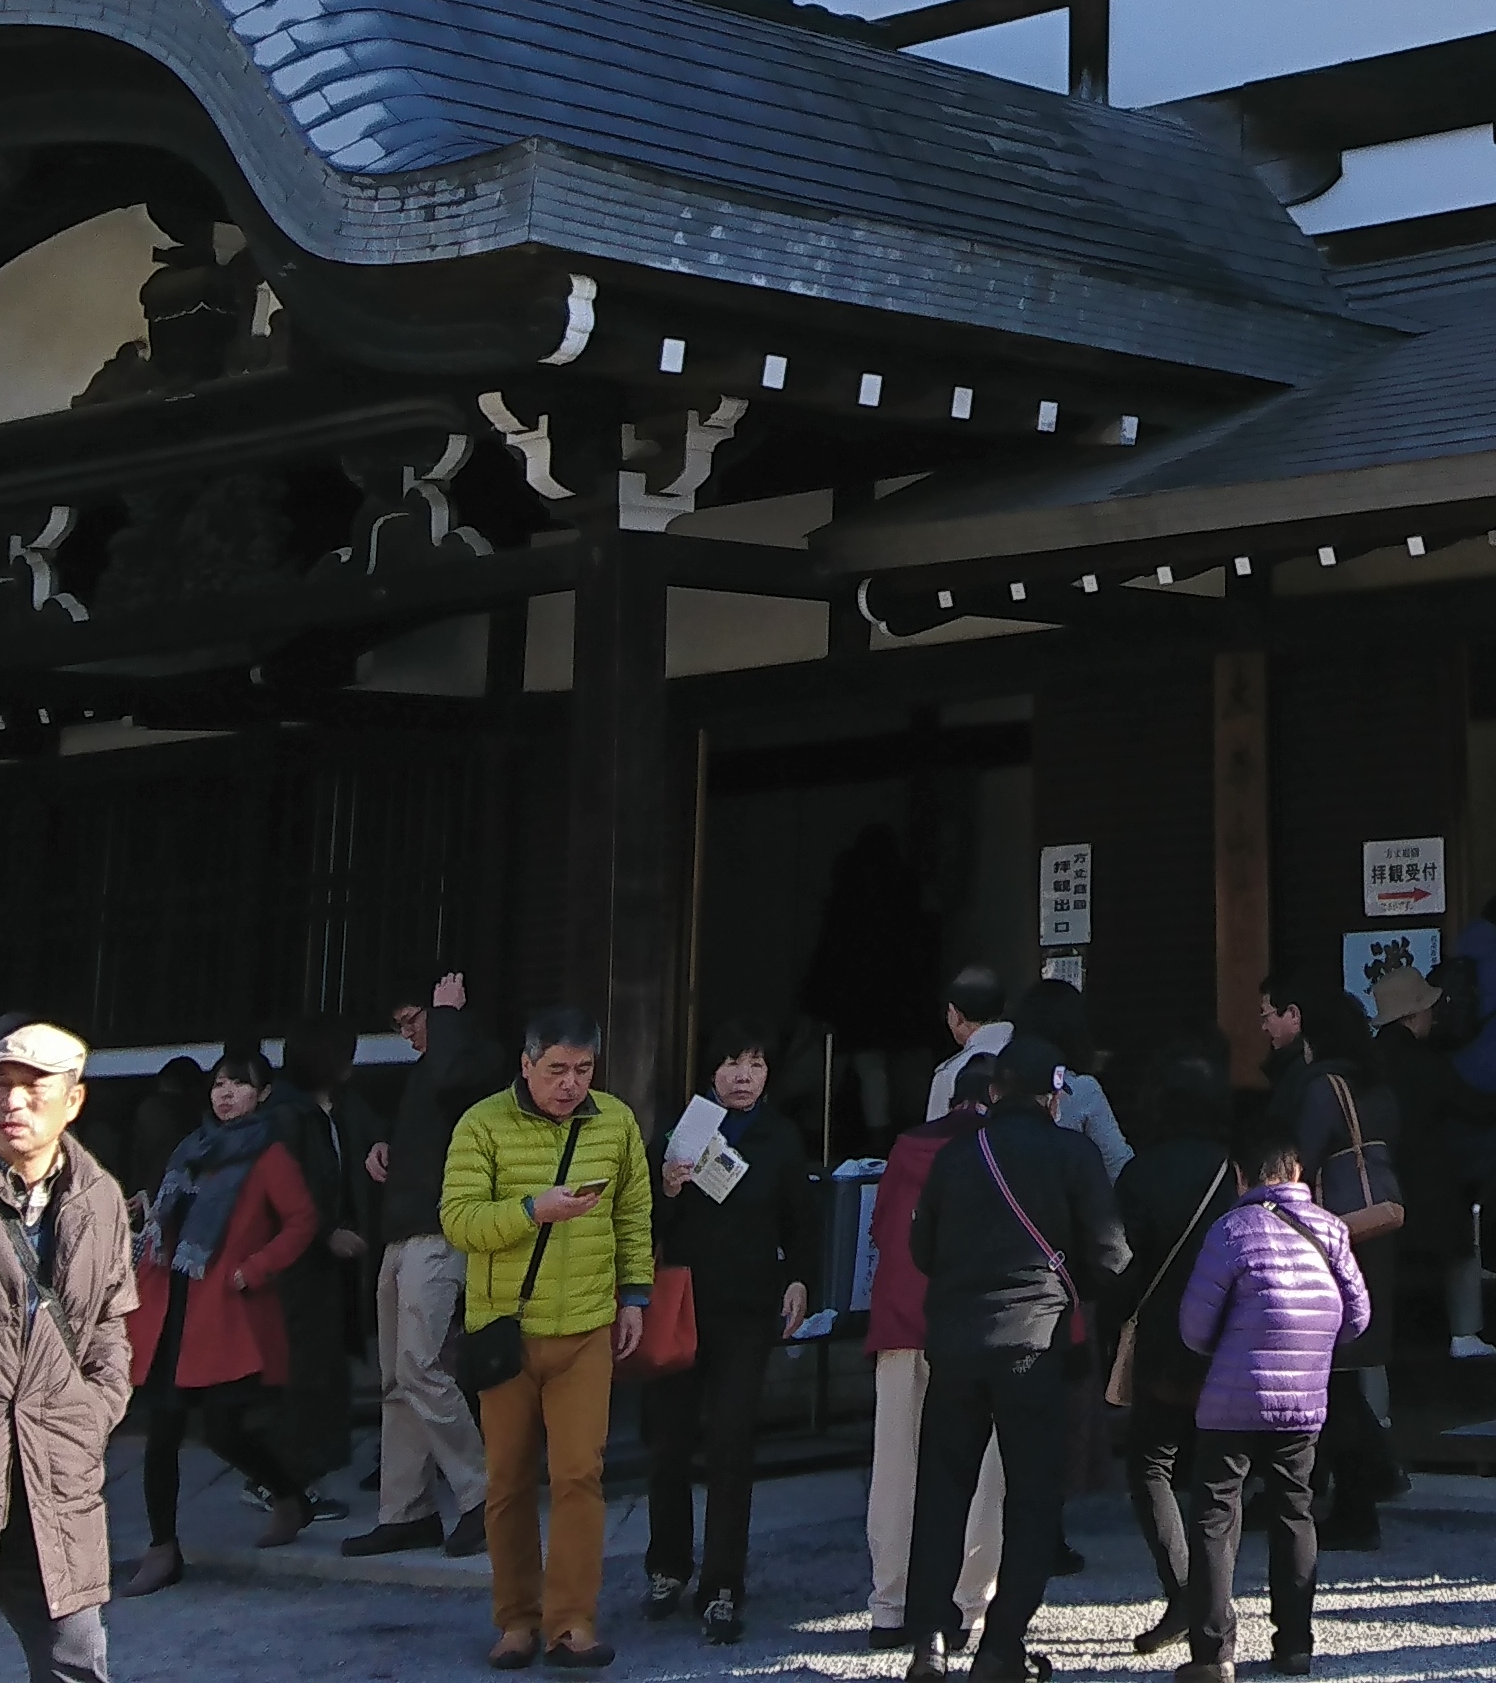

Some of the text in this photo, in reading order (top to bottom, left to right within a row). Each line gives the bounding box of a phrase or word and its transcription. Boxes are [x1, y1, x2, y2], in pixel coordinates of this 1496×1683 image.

[1053, 860, 1071, 933] 拝観出口
[1371, 862, 1438, 885] 拝観受付
